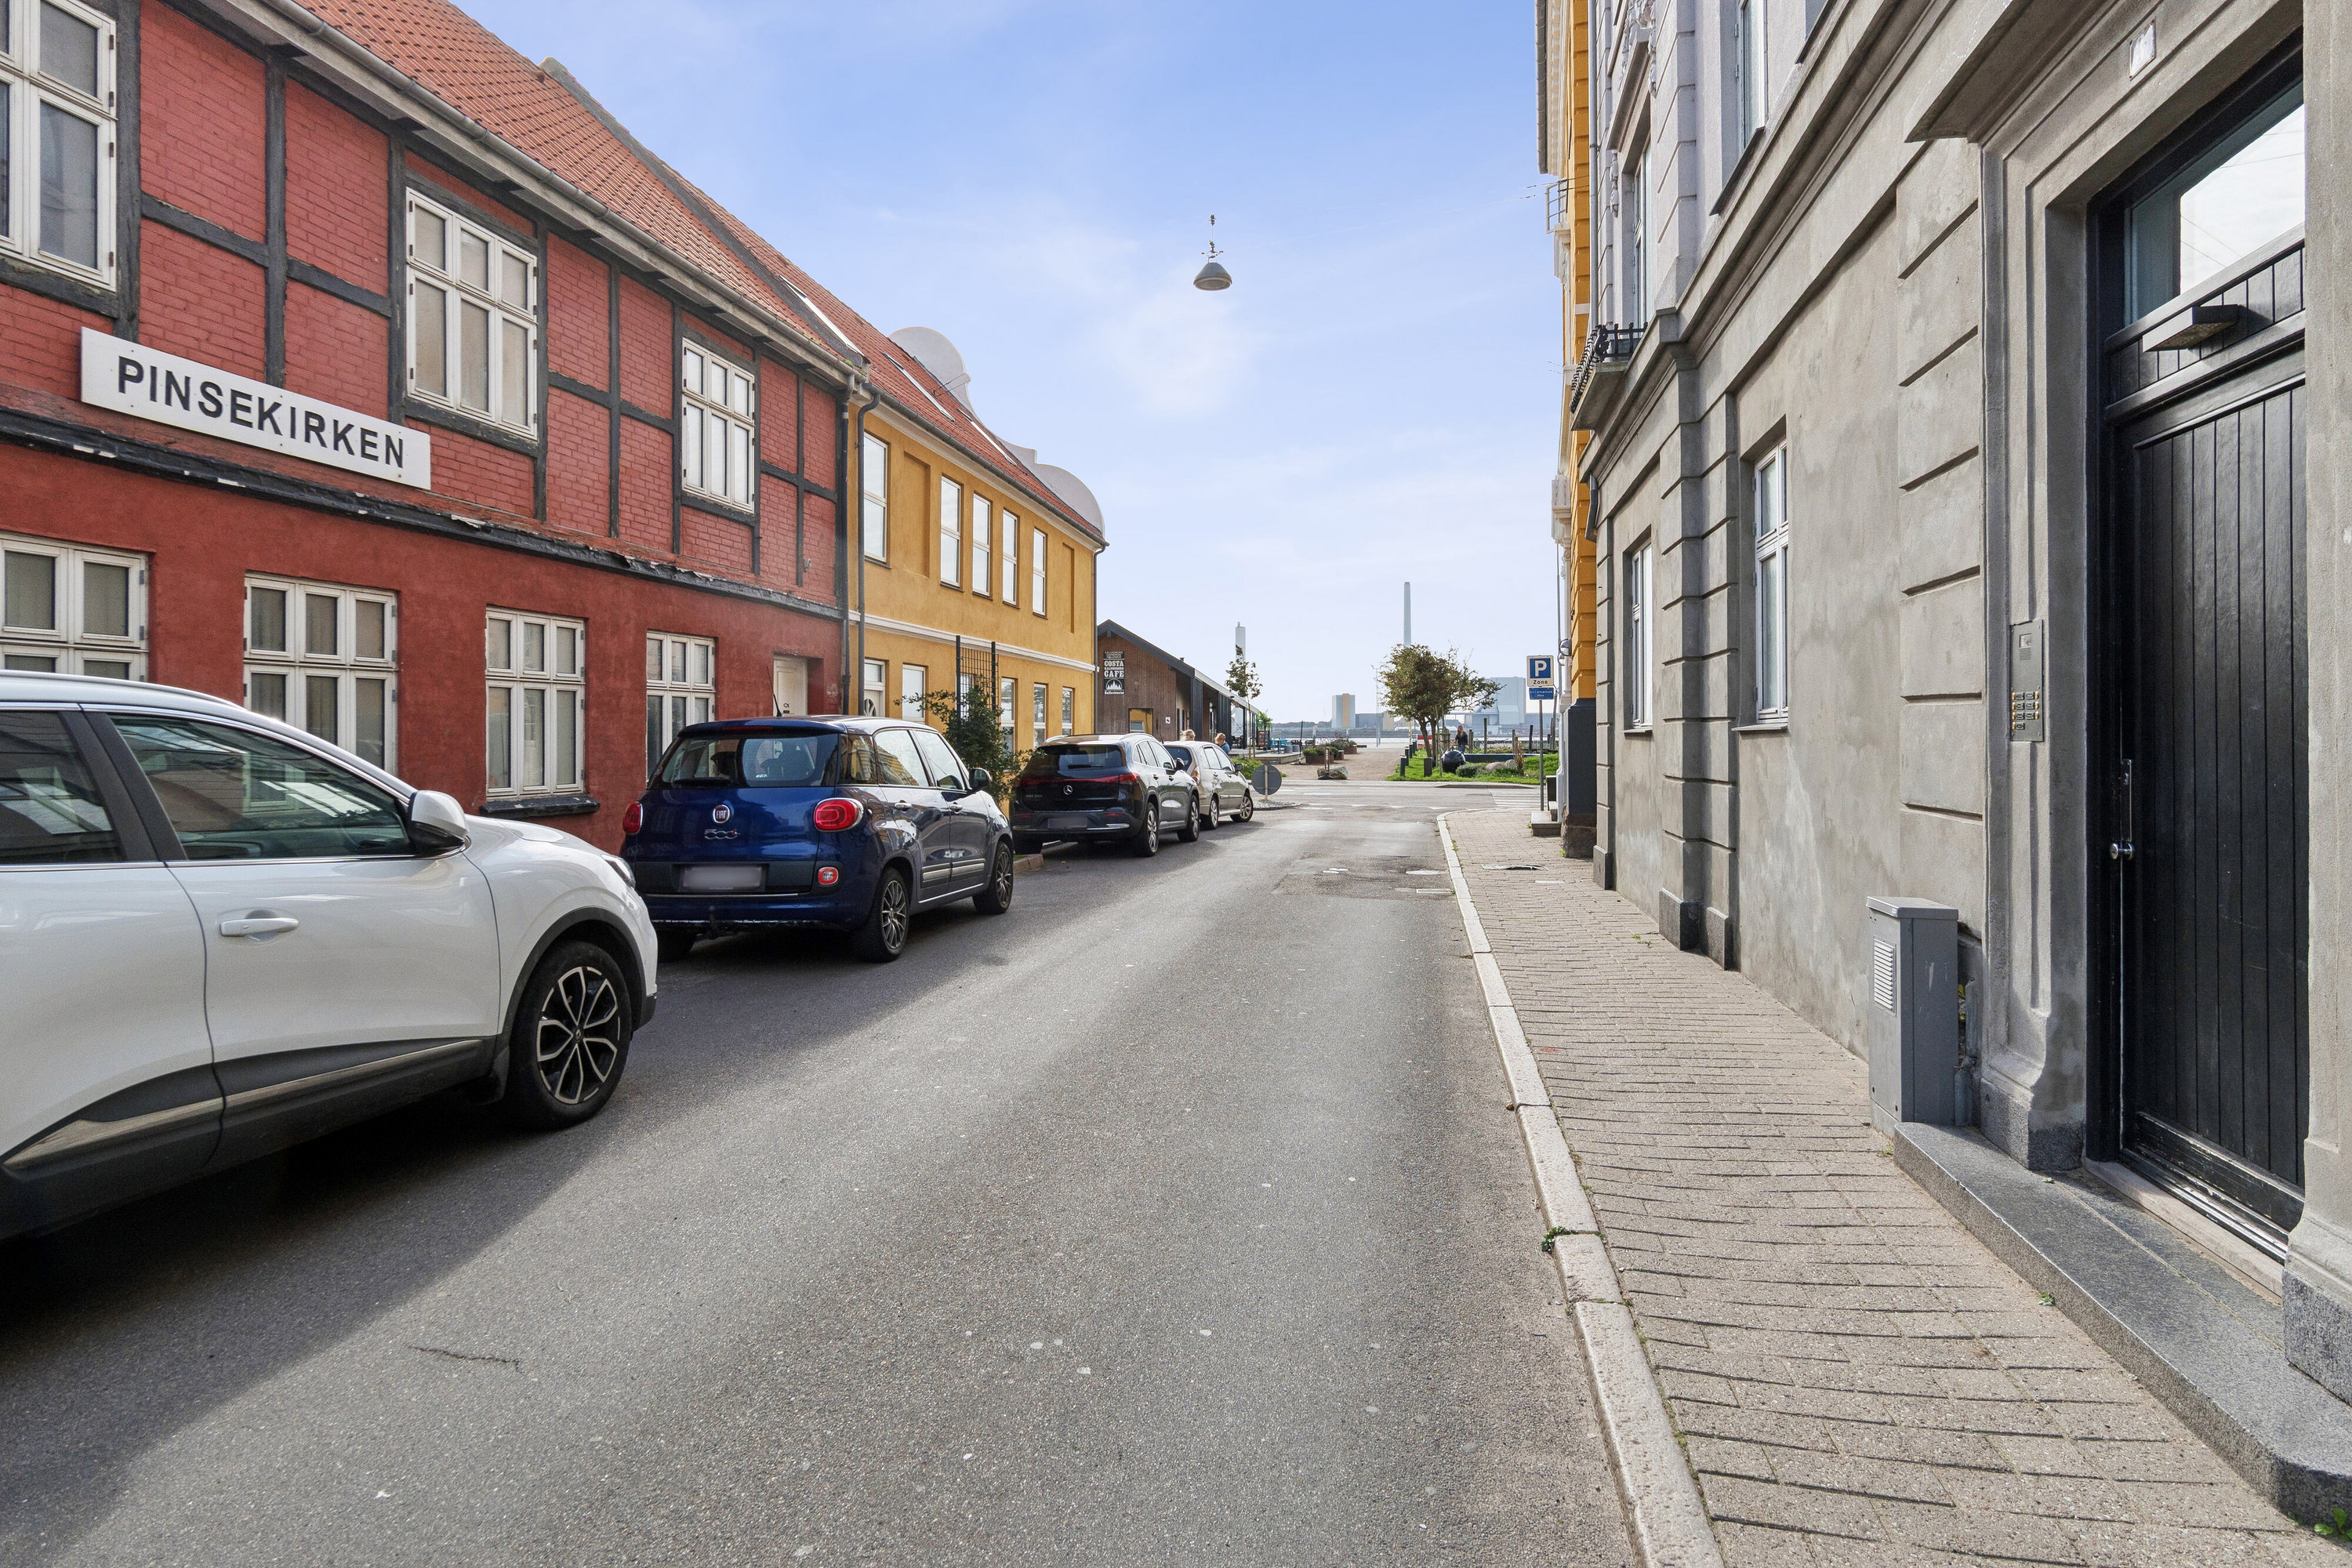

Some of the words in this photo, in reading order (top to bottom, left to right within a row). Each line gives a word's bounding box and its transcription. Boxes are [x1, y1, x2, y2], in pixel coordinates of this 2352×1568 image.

[118, 355, 404, 469] PINSEKIRKEN
[1534, 660, 1547, 677] P
[716, 810, 727, 819] FIAT
